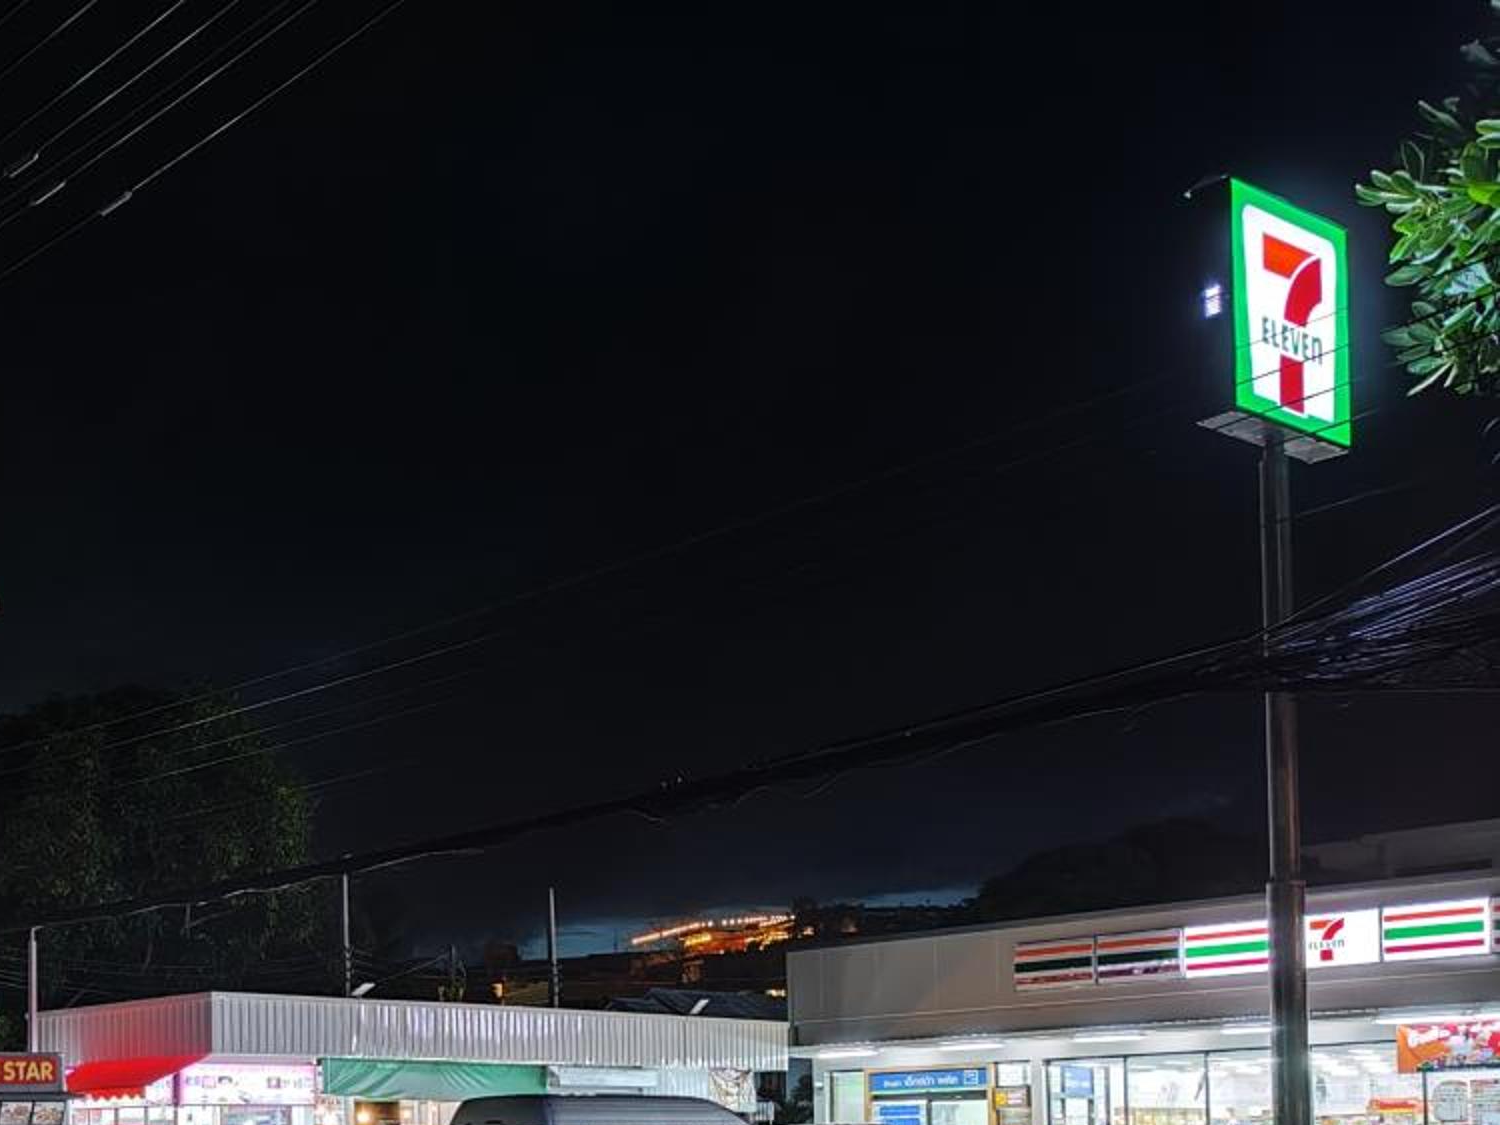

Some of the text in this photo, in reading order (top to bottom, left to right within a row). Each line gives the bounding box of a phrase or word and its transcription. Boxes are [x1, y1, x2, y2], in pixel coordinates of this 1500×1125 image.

[1263, 233, 1323, 414] 7
[1309, 917, 1345, 961] 7
[3, 1062, 53, 1080] STAR
